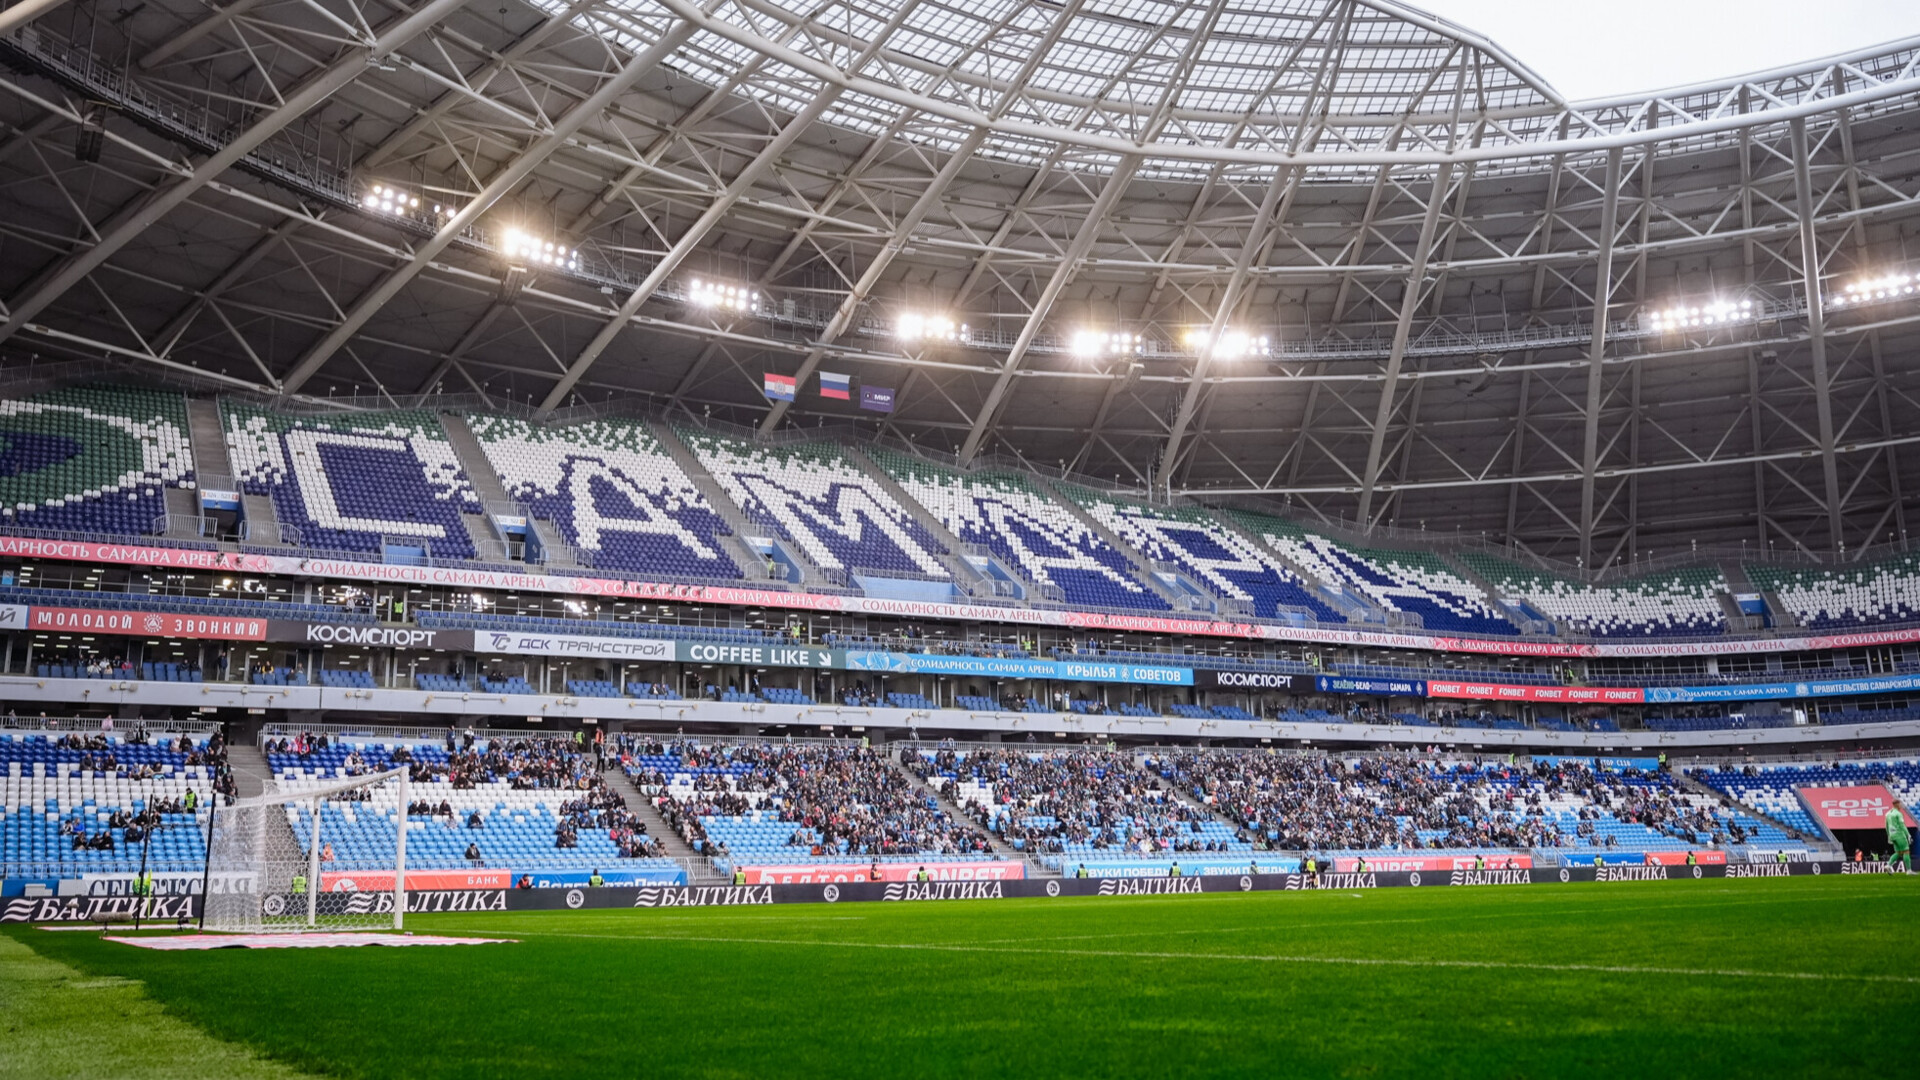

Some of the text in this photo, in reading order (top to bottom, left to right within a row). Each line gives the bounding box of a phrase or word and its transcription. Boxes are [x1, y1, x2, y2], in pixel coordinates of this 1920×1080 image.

[874, 394, 891, 402] МИР
[97, 546, 171, 563] САМАРА
[177, 553, 230, 568] АРЕНА
[301, 560, 546, 589] СОЛИДАРНОСТЬ САМАРА АРЕНА
[604, 582, 814, 606] СОЛИДАРНОСТЬ САМАРА АРЕНА
[862, 600, 1042, 622] СОЛИДАРНОСТЬ САМАРА АРЕНА
[38, 611, 132, 629] МОЛОДОЙ
[174, 618, 259, 636] ЗВОНКИЙ
[1086, 615, 1167, 630] СОЛИДАРНОСТЬ
[1170, 619, 1211, 632] САМАРА
[1279, 629, 1416, 646] СОЛИДАРНОСТЬ САМАРА АРЕНА
[518, 638, 551, 650] ДСК
[557, 640, 666, 656] ТРАНССТРОЙ
[1448, 640, 1511, 652] СОЛИДАРНОСТЬ
[1513, 643, 1547, 654] САМАРА
[1616, 641, 1785, 656] СОЛИДАРНОСТЬ САМАРА АРЕНА
[690, 645, 809, 666] COFFEE LIKE
[910, 658, 1055, 675] СОЛИДАРНОСТЬ САМАРА АРЕНА
[1067, 666, 1181, 682] КРЫЛЬЯ СОВЕТОВ
[1390, 683, 1412, 692] САМАРА
[1433, 684, 1637, 700] FONBET FONBET FONBET FONBET FONBET FONBET
[1677, 690, 1731, 698] СОЛИДАРНОСТЬ
[1733, 688, 1764, 696] САМАРА
[1813, 678, 1920, 693] ПРАВИТЕЛЬСТВО САМАРСКОЙ О
[1821, 797, 1883, 809] FON
[1828, 806, 1890, 818] BET
[1088, 868, 1120, 878] ВУКИ
[1203, 866, 1288, 876] ЗВУКИ ПБЕДЫ
[1464, 869, 1532, 886] БАЛТИКА
[1608, 866, 1668, 882] БАЛТИКА
[1737, 863, 1790, 877] БАЛТИКА
[467, 875, 499, 885] БАНК
[1117, 877, 1203, 895] БАЛТИКА
[659, 886, 774, 907] БАЛТИКА
[904, 881, 1003, 900] БАЛТИКА
[35, 896, 194, 921] БАЛТИКА
